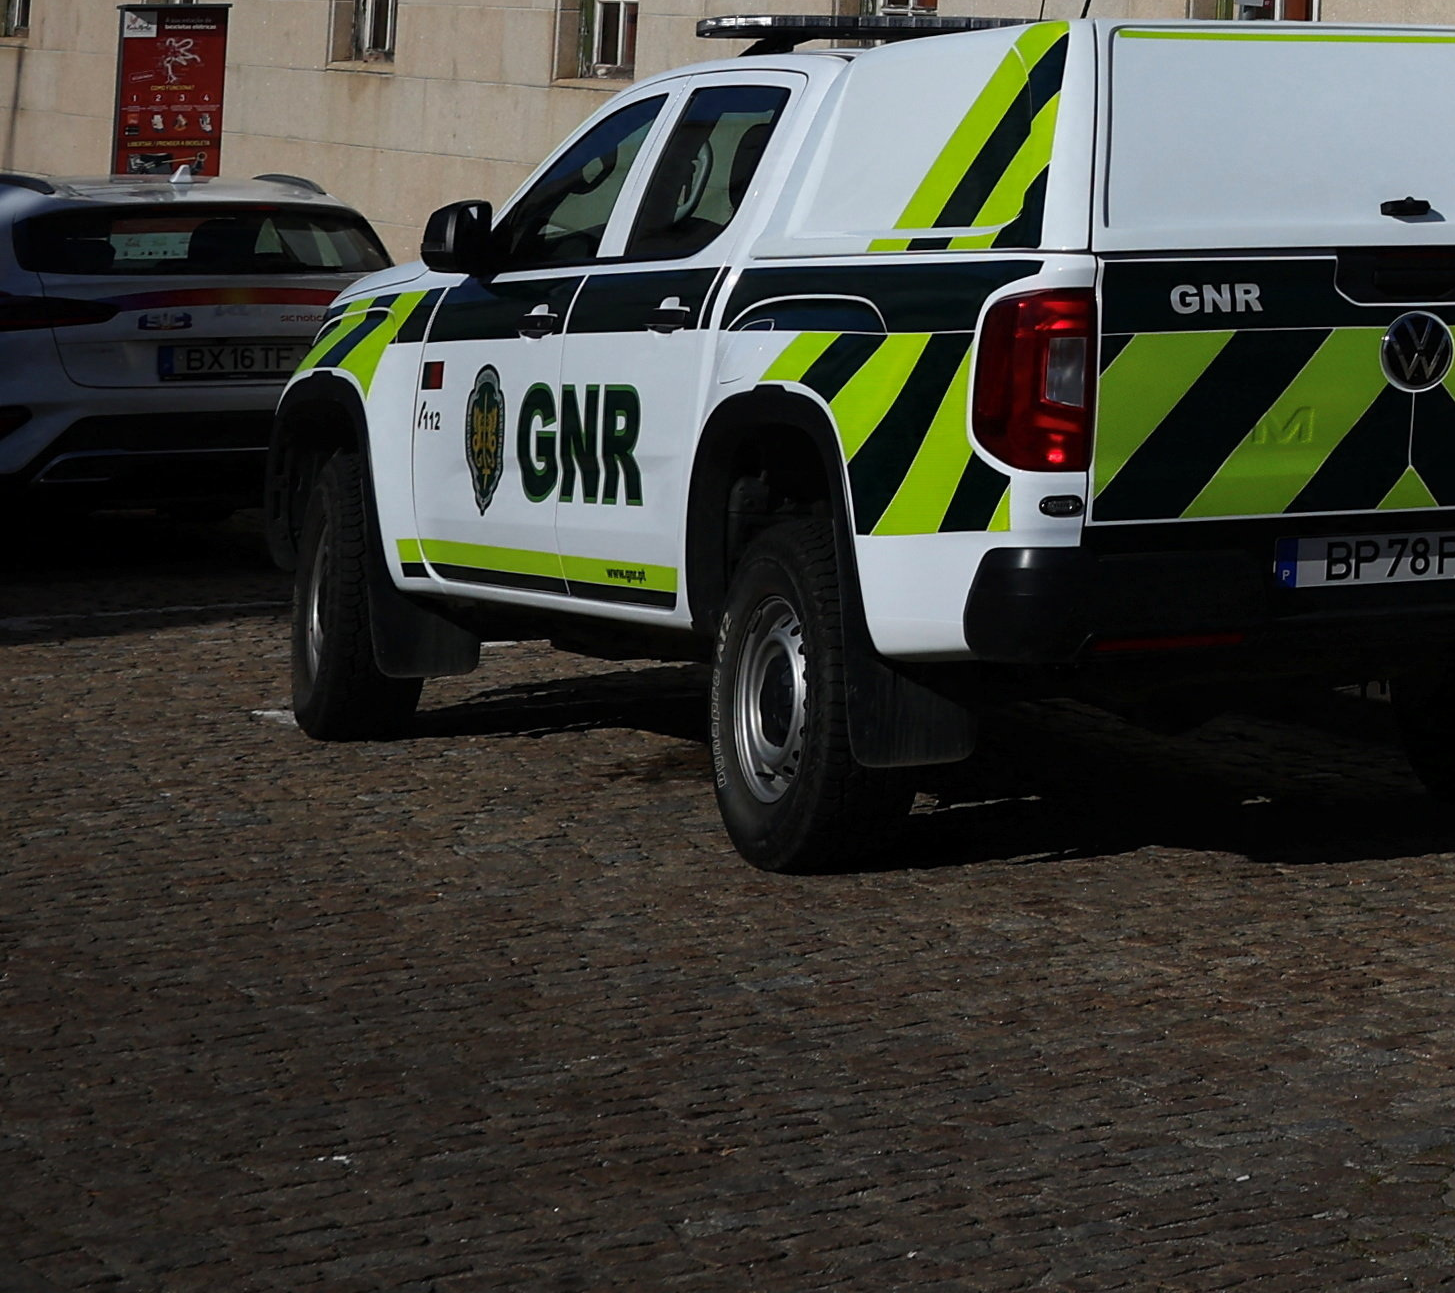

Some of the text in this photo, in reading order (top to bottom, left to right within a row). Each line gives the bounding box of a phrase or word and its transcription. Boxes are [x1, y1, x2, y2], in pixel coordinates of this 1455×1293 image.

[133, 94, 137, 102] 1
[155, 94, 162, 102] 2
[179, 94, 185, 102] 3
[203, 94, 209, 102] 4
[1170, 283, 1264, 314] GNR
[186, 347, 294, 371] BX 16 TF
[423, 411, 441, 431] 112
[516, 382, 644, 507] GNR
[1282, 570, 1290, 581] P
[1326, 539, 1380, 581] BP
[1385, 537, 1430, 578] 78
